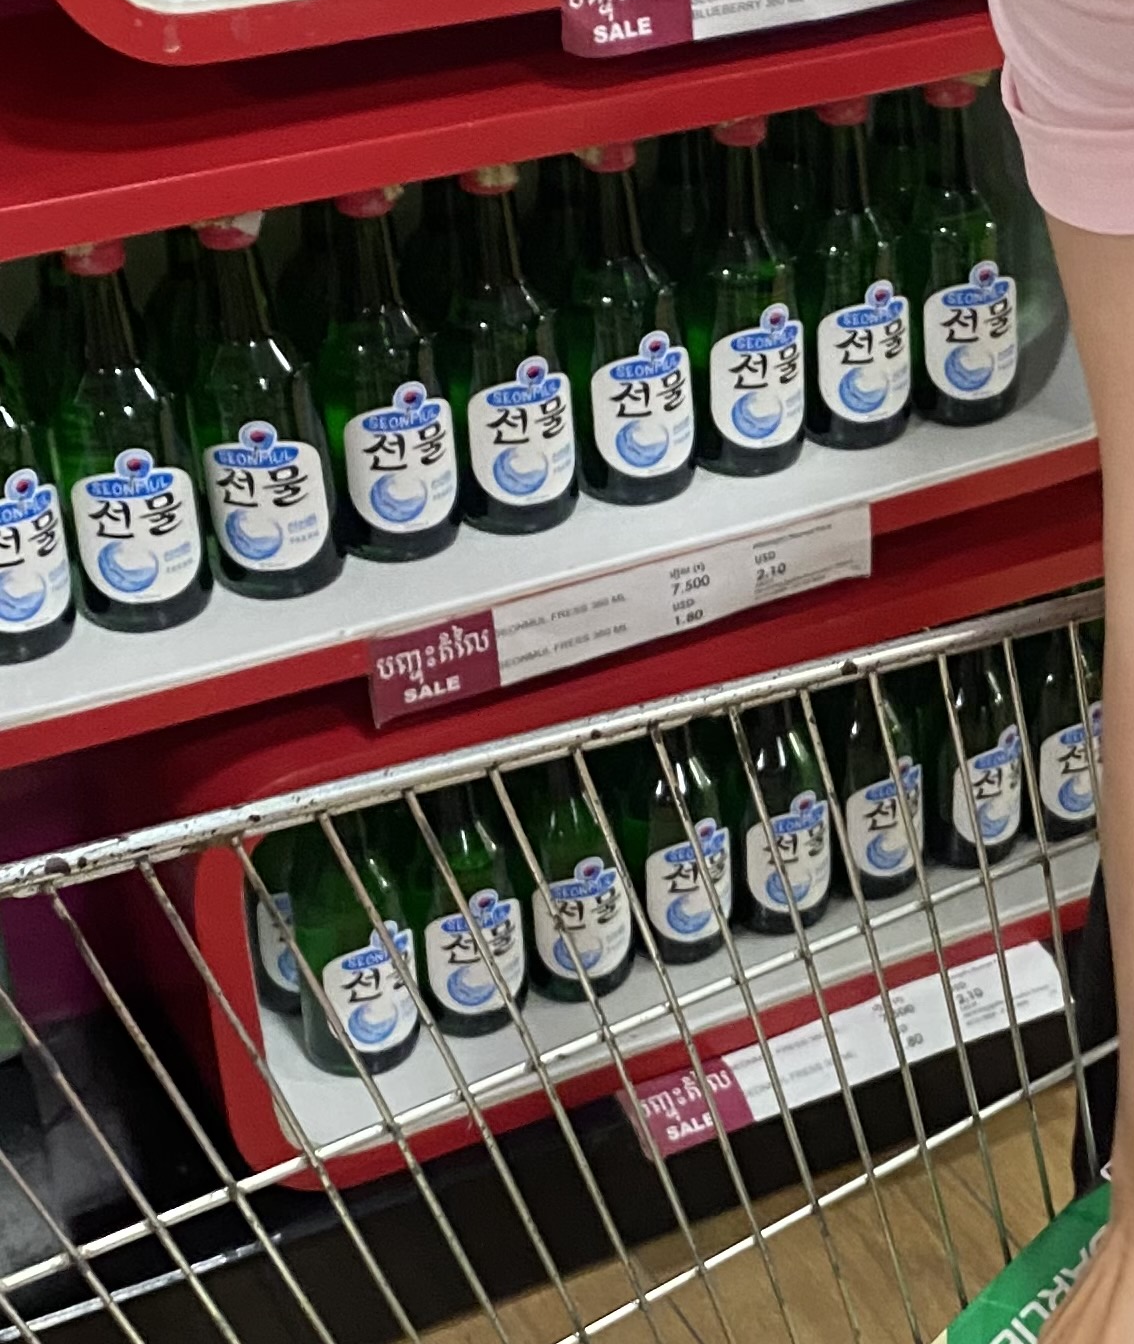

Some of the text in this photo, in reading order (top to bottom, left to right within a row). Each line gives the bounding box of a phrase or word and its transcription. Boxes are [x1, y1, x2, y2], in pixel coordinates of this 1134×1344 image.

[593, 17, 653, 43] SALE
[756, 563, 787, 581] 2.10
[675, 609, 704, 626] 1.80
[404, 675, 461, 703] SALE
